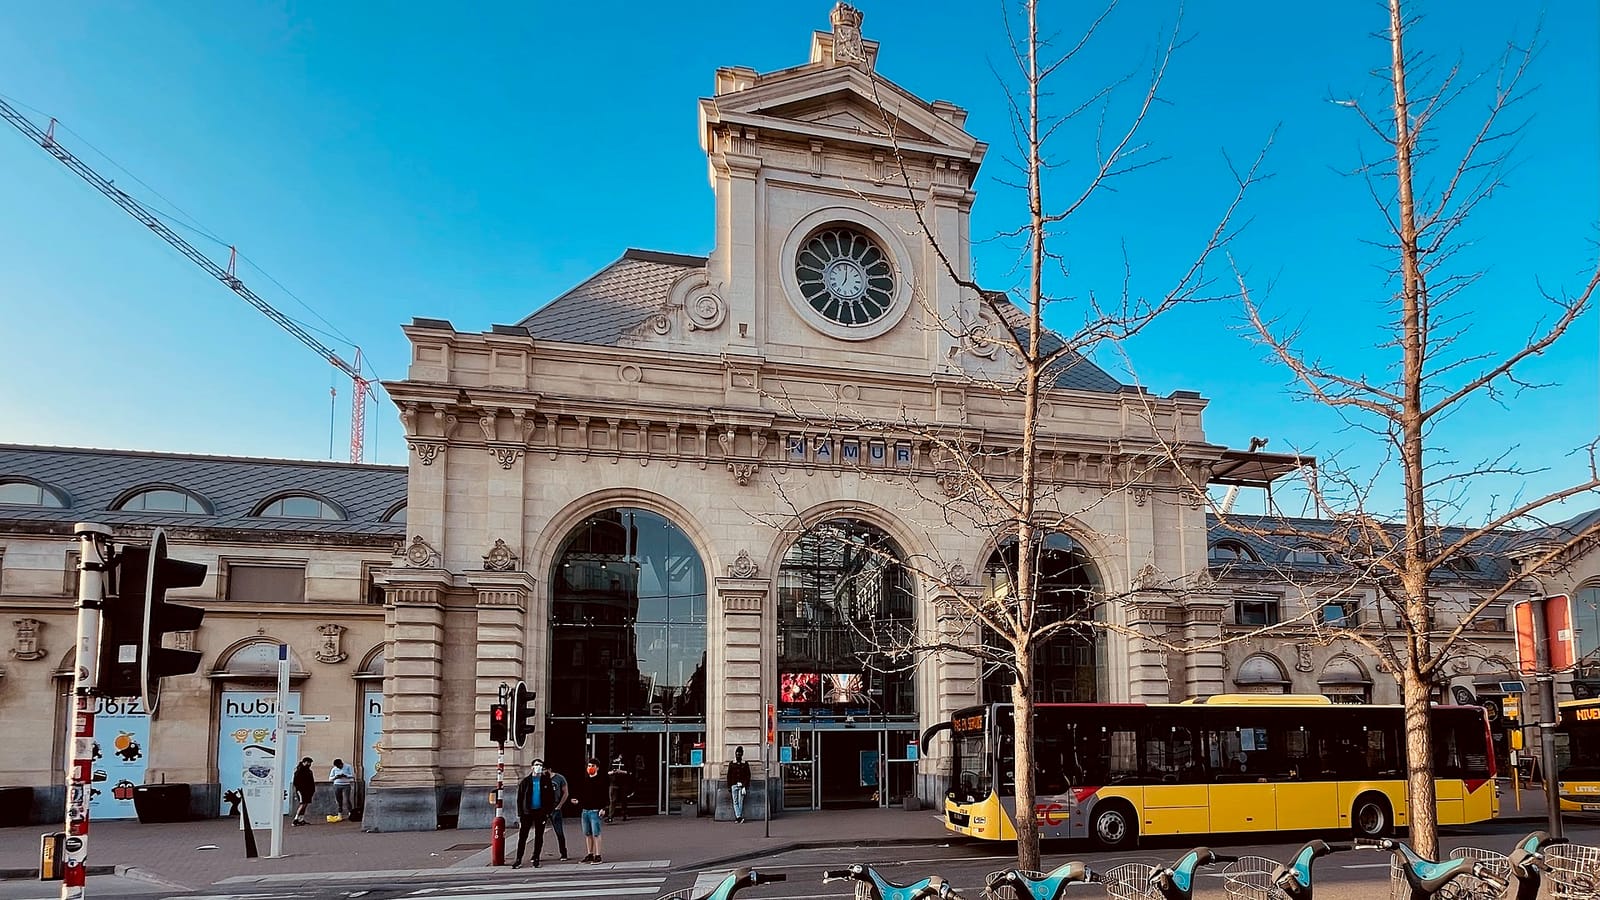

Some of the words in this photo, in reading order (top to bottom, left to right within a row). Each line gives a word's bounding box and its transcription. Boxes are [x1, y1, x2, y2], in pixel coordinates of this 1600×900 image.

[791, 441, 909, 460] NAMUR
[95, 698, 146, 714] ubiz
[226, 698, 295, 714] hubi
[1036, 803, 1063, 826] EC
